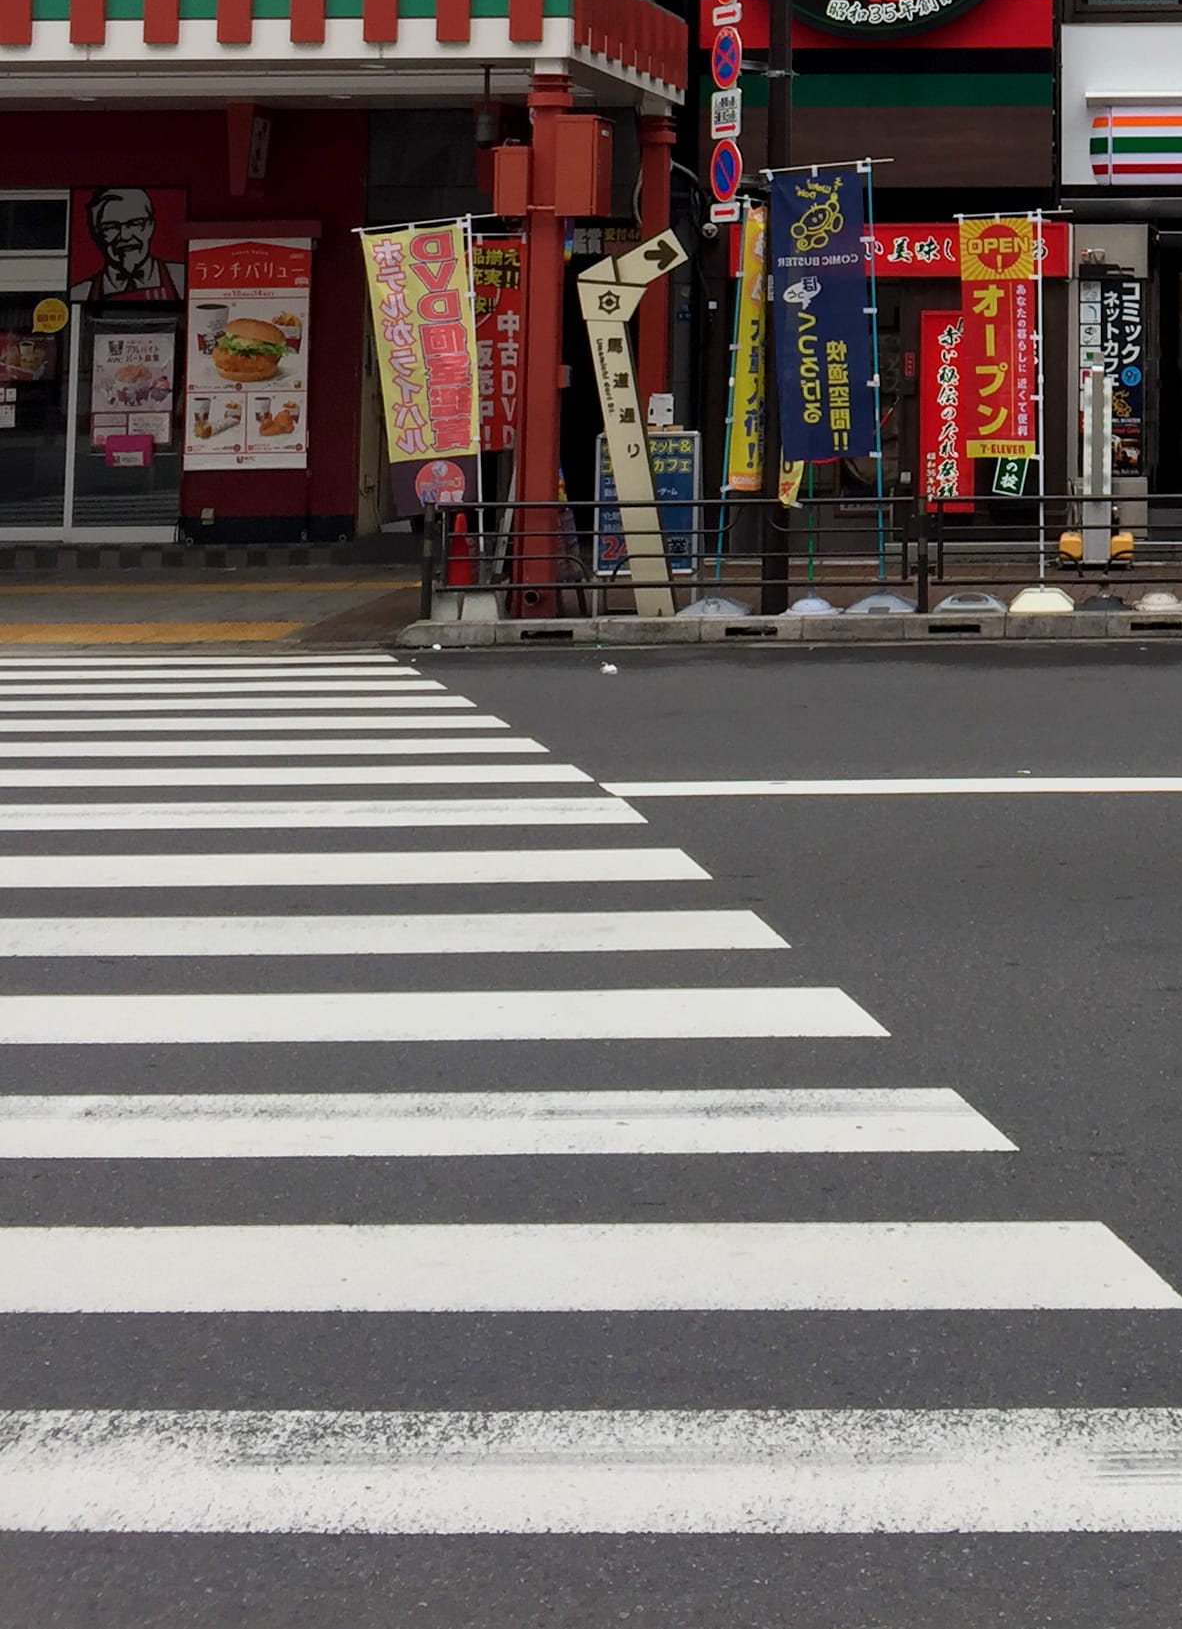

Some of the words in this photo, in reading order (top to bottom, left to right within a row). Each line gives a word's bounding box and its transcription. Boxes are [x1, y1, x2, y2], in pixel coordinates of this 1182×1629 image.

[195, 261, 305, 280] ランチバリュー
[967, 236, 1031, 254] OPEN
[972, 284, 1008, 436] オープン
[1121, 281, 1142, 364] コミック
[606, 336, 642, 460] 馬道通り
